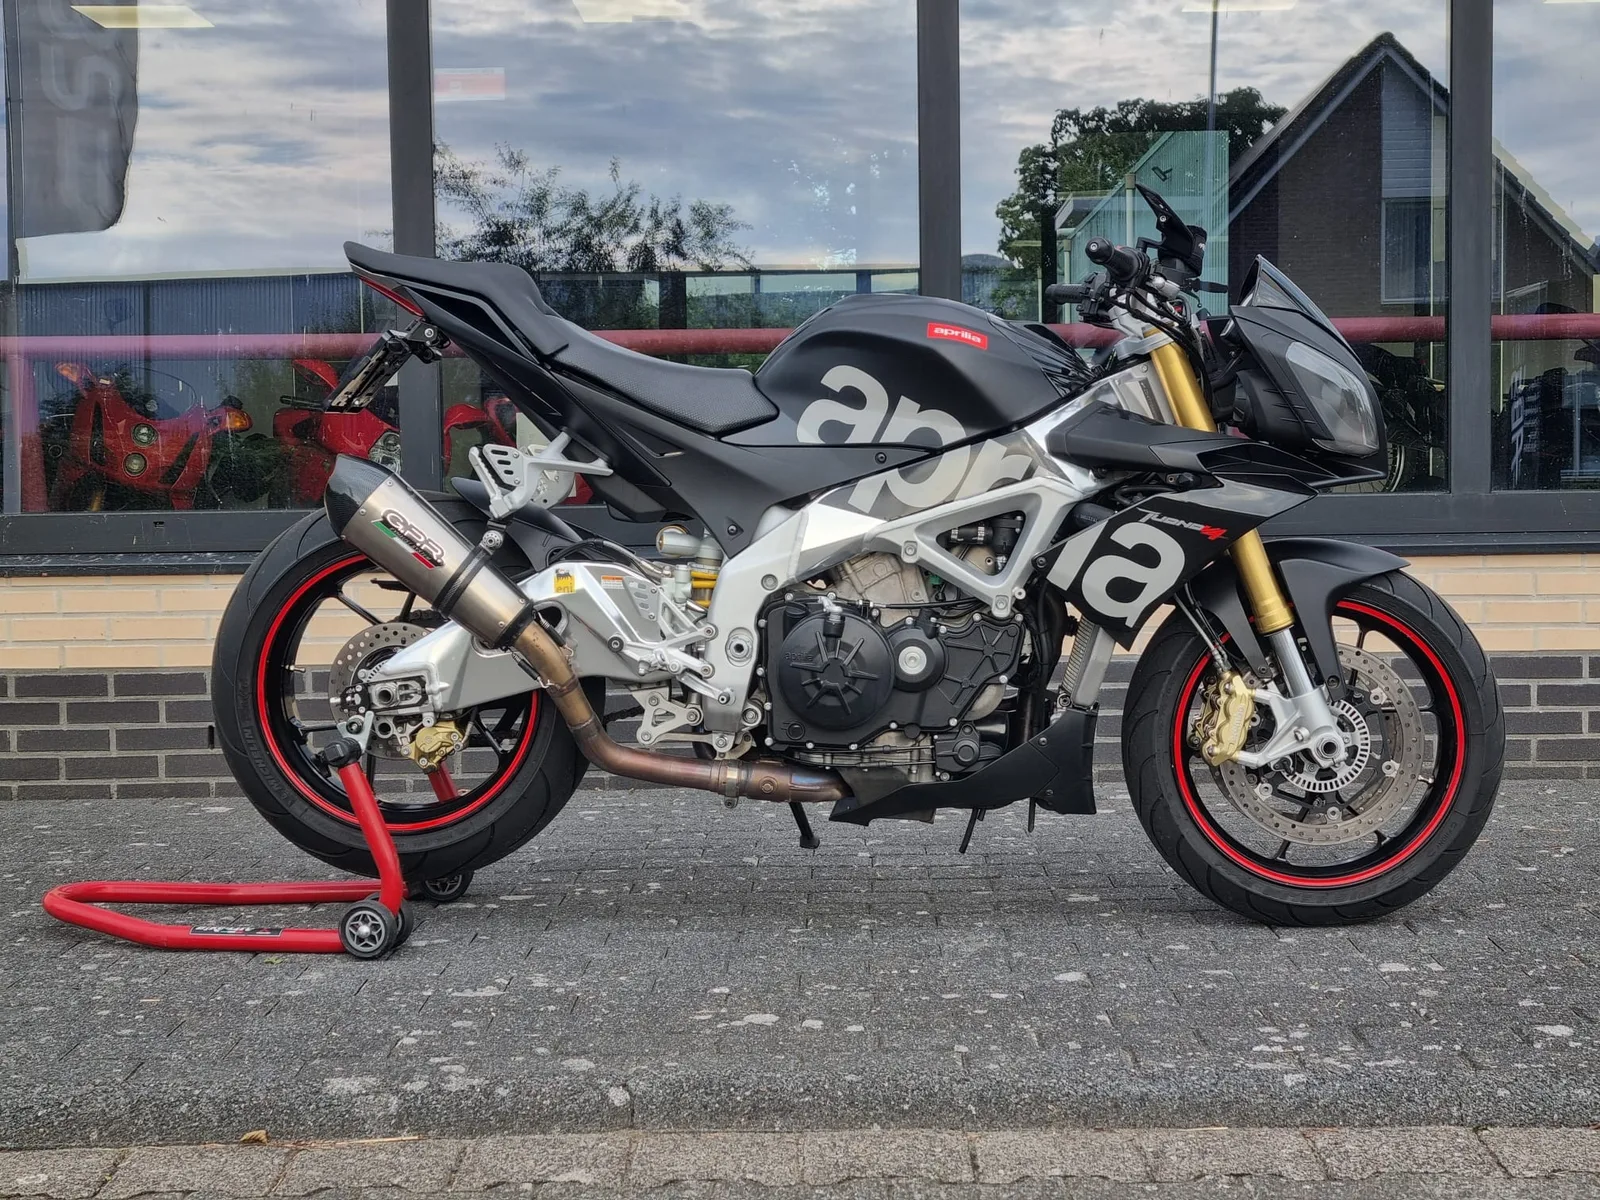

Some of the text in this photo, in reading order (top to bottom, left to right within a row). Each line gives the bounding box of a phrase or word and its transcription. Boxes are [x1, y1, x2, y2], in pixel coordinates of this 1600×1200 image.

[933, 327, 982, 343] aprilia
[556, 582, 573, 593] eni
[242, 726, 285, 796] MICHELIN
